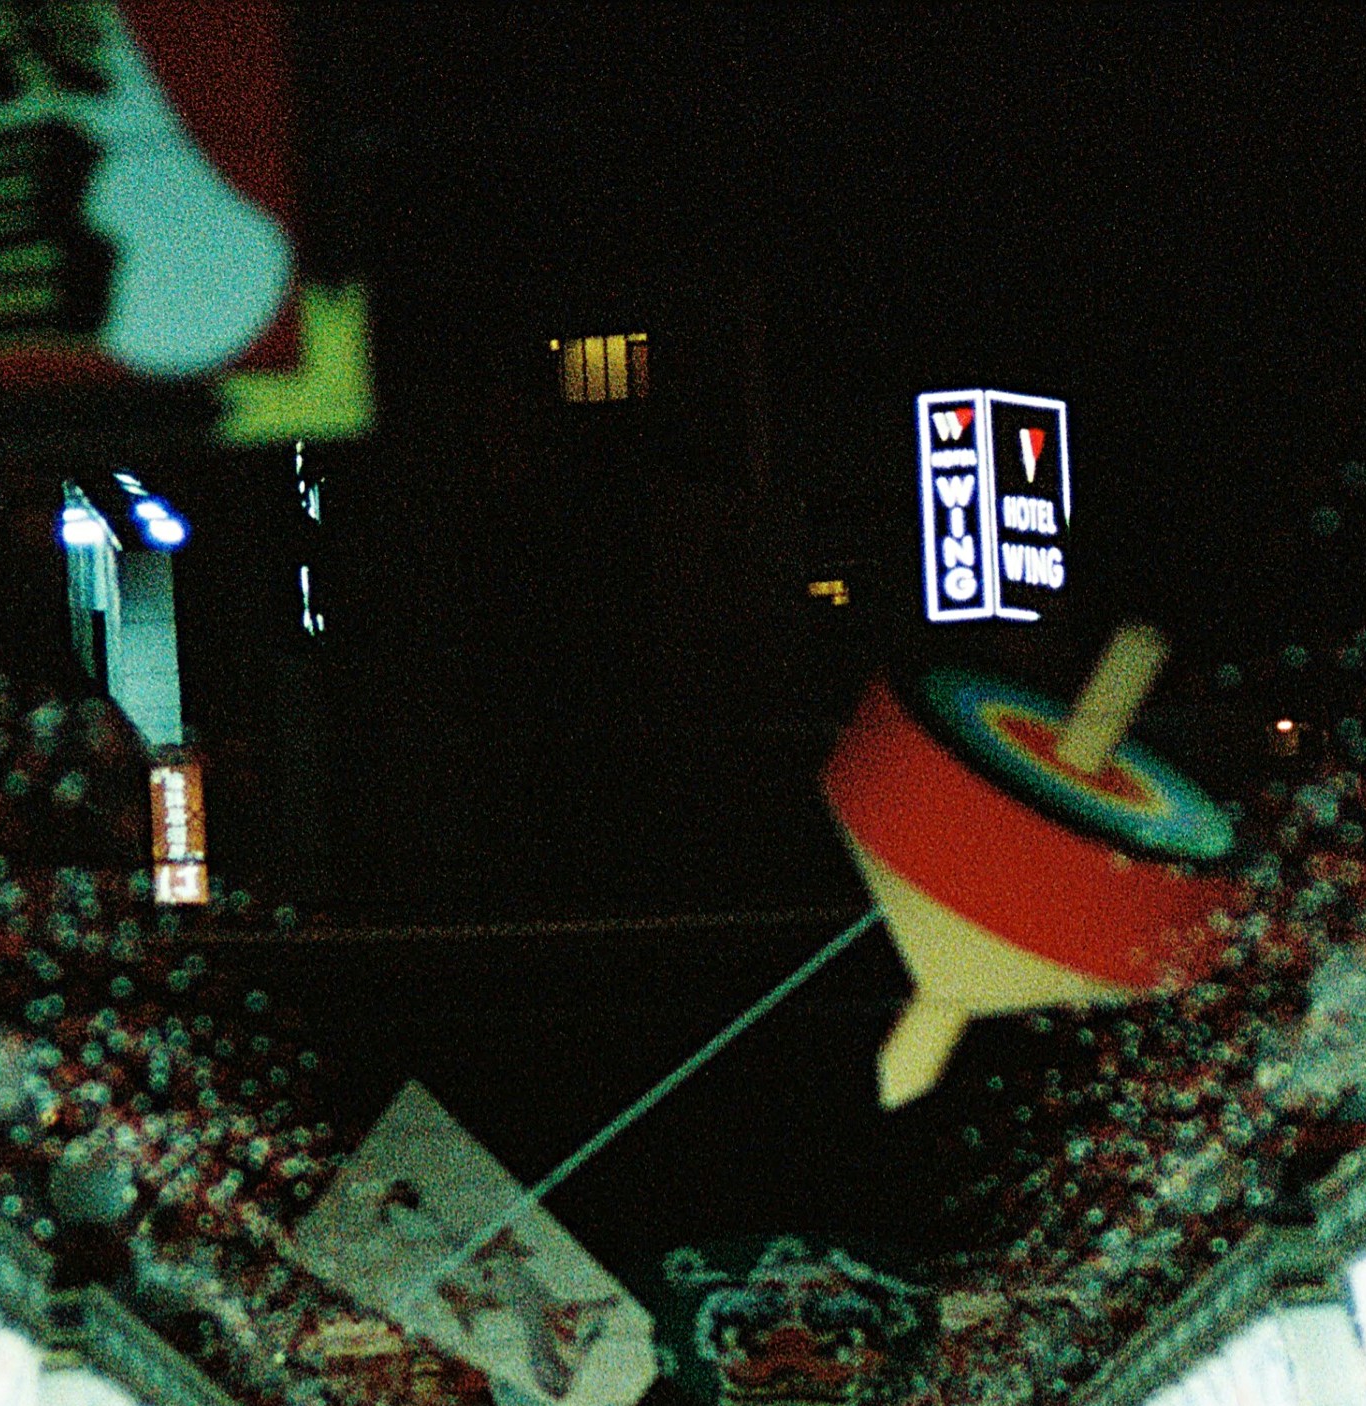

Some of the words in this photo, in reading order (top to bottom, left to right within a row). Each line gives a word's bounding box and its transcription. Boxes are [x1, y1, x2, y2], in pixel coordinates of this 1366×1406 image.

[936, 474, 978, 600] WING
[1002, 495, 1057, 534] HOTEL
[1001, 542, 1064, 589] WING
